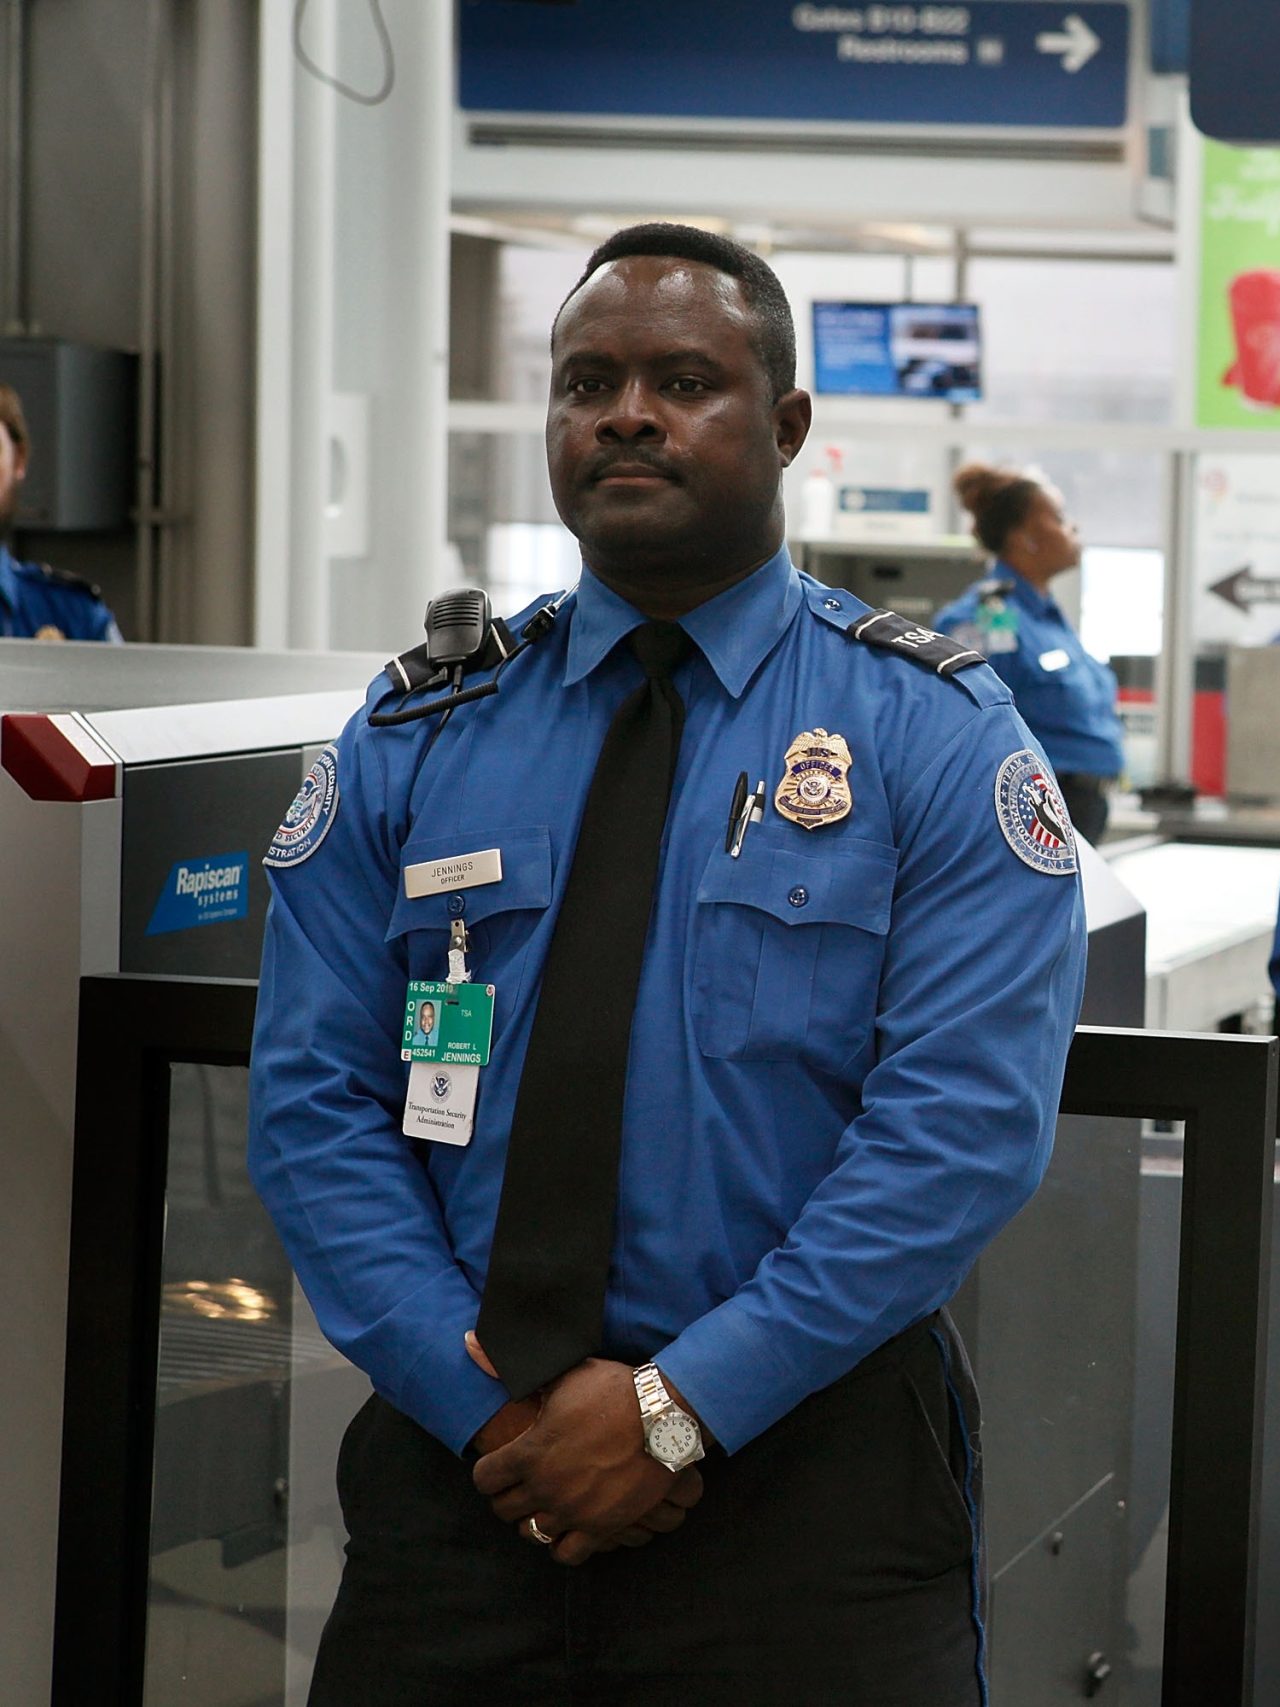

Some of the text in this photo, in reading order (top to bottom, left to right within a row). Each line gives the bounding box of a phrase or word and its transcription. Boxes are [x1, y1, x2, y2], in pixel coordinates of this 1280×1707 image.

[891, 628, 944, 648] TSA
[800, 760, 834, 773] OFFICER
[1002, 758, 1025, 786] TEAM
[431, 861, 473, 878] JENNINGS
[176, 864, 241, 898] Rapiscan
[440, 874, 465, 885] OFFICER
[198, 889, 238, 908] systems
[409, 982, 418, 992] 16
[420, 983, 434, 995] Sep
[461, 1009, 472, 1018] TSA
[447, 1041, 470, 1050] ROBERT
[441, 1052, 481, 1063] JENNINGS
[408, 1101, 467, 1121] Transportation Security
[416, 1115, 455, 1129] Administration
